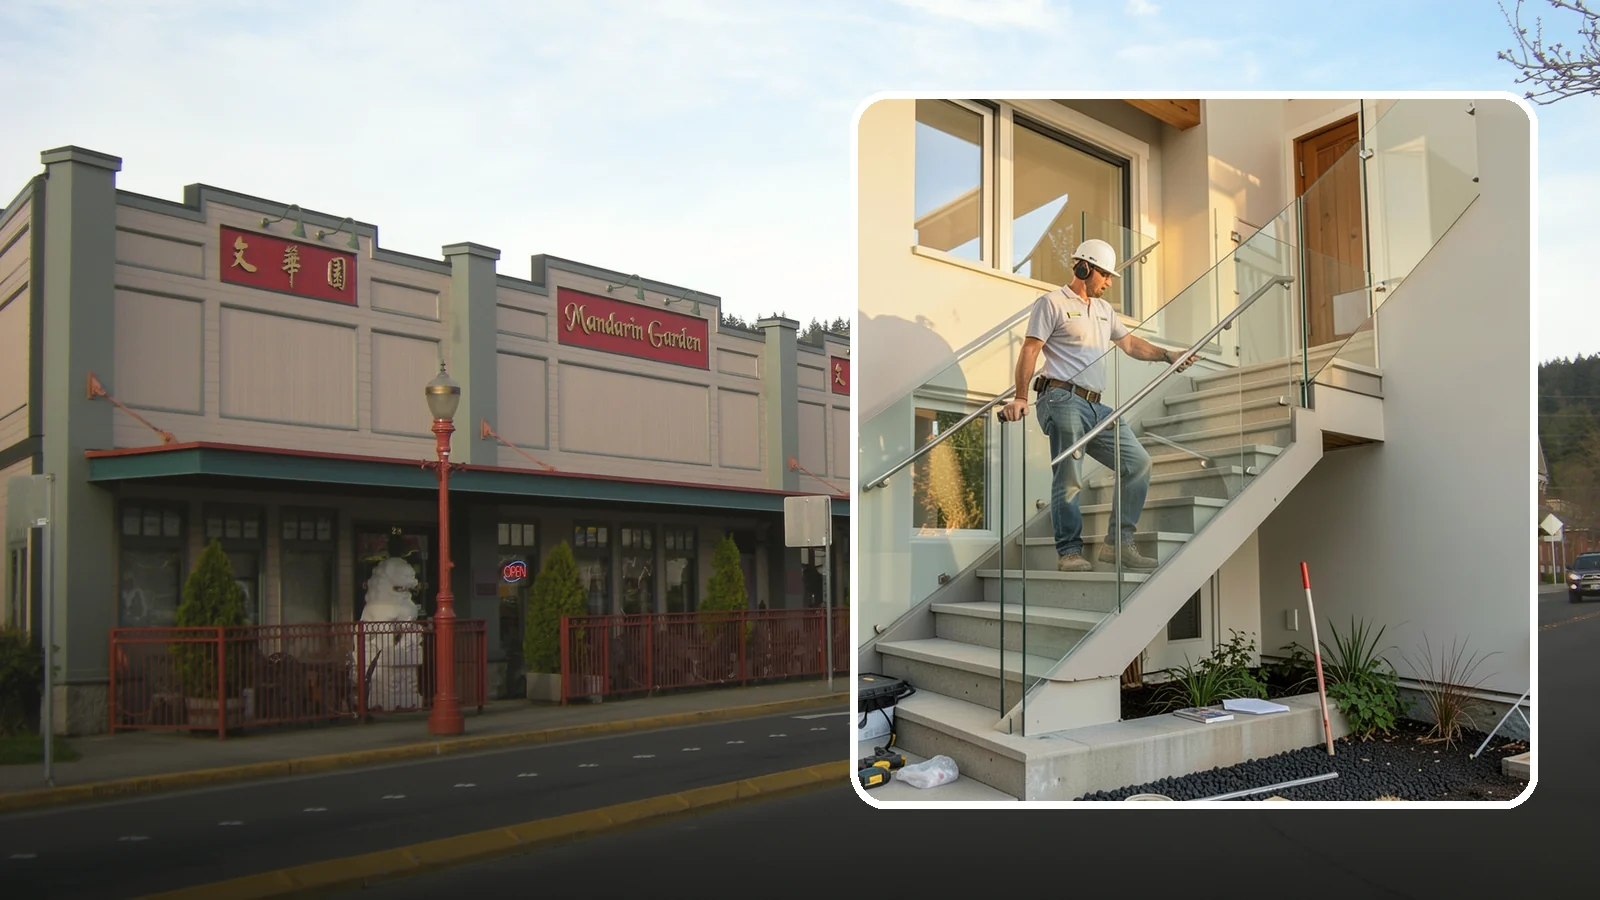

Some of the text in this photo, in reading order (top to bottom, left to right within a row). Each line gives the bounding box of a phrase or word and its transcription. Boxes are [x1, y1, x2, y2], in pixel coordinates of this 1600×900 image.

[231, 236, 347, 291] 文華園
[564, 302, 702, 352] Mandarin Garden
[503, 565, 527, 578] OPEN
